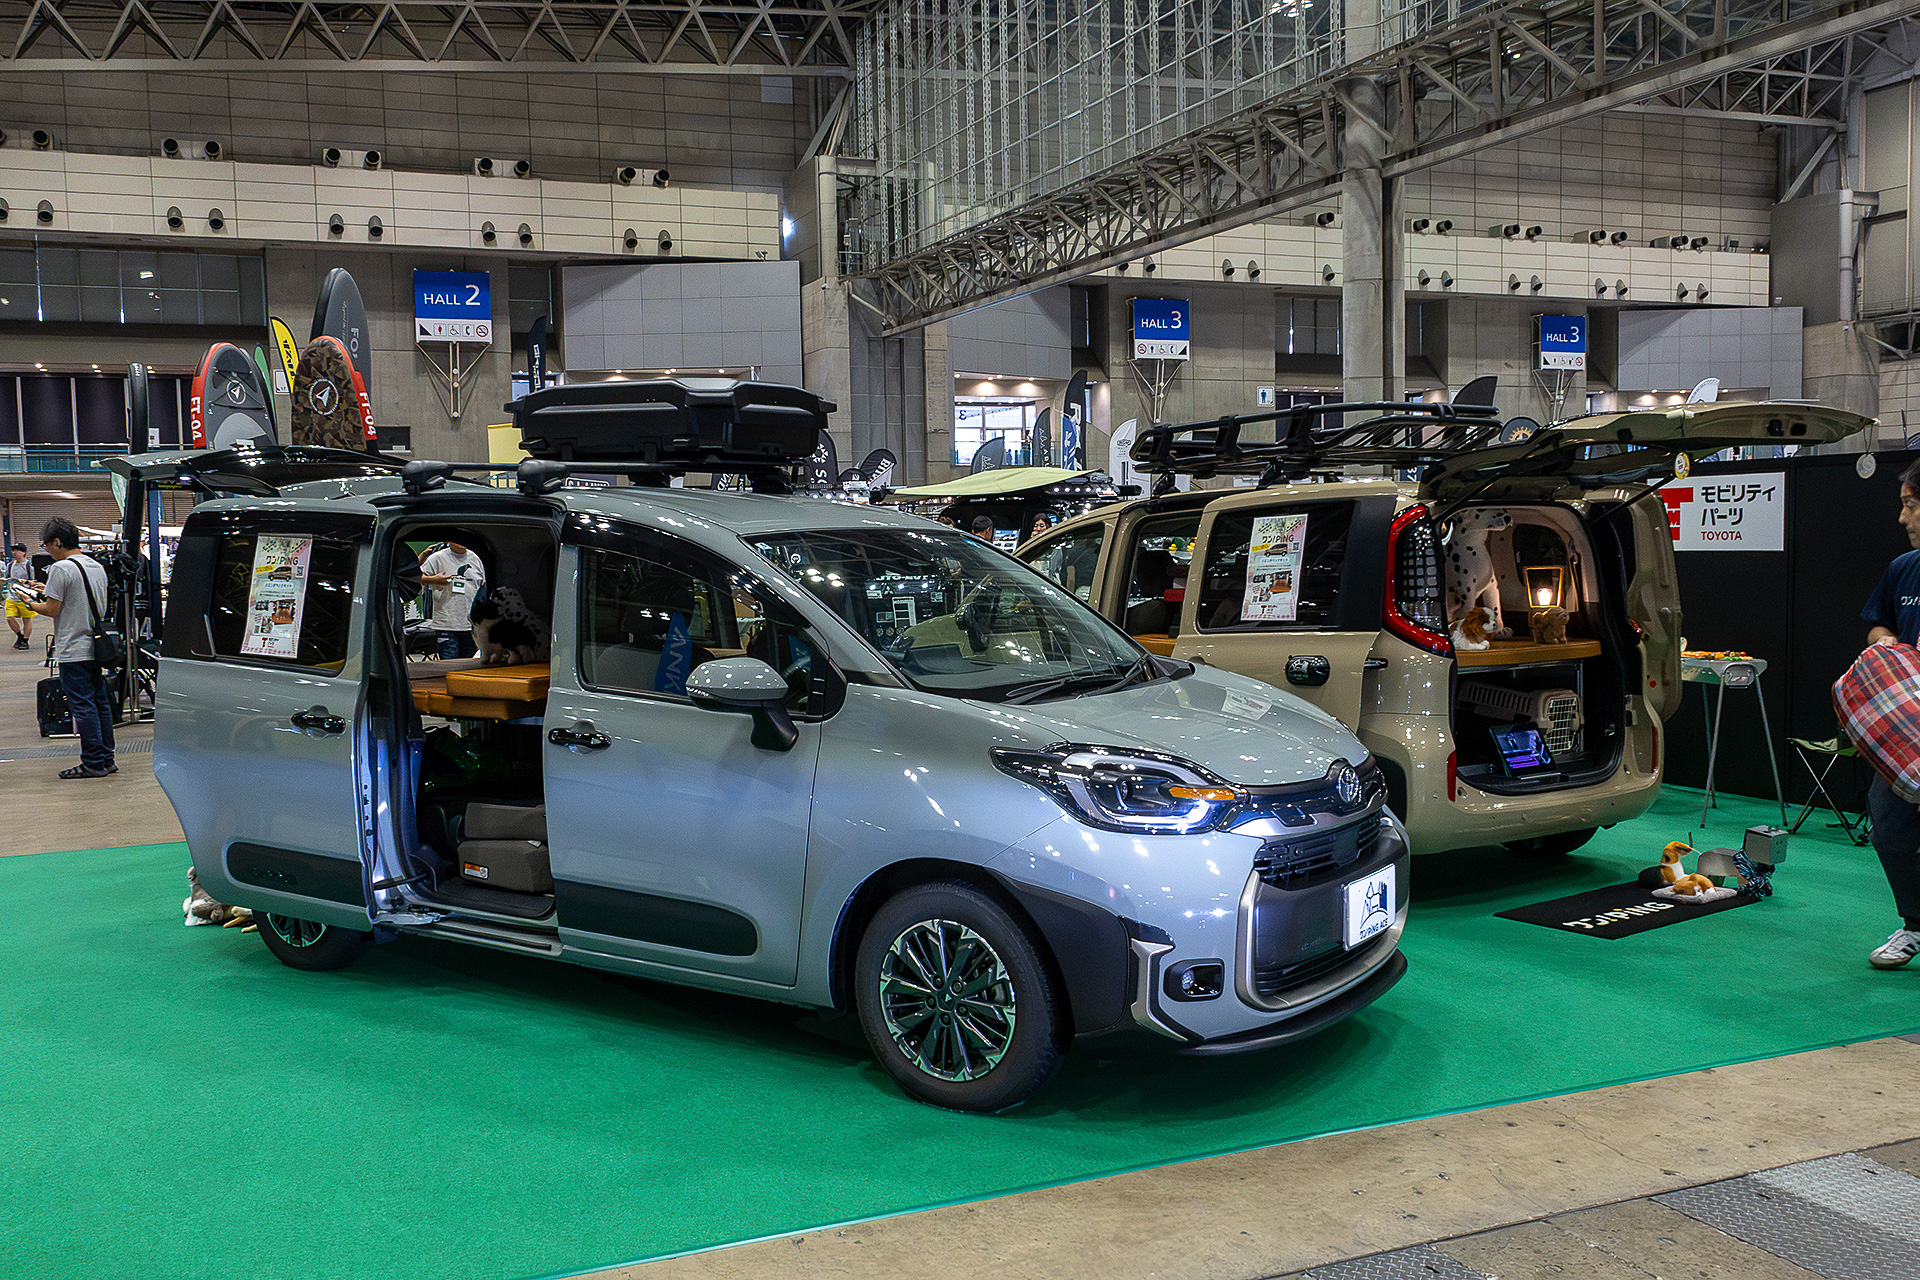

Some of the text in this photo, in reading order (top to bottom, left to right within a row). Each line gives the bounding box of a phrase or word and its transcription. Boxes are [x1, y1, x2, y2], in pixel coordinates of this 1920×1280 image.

[423, 284, 481, 306] HALL 2
[1141, 310, 1182, 329] HALL 3
[1546, 326, 1580, 343] HALL 3
[359, 392, 377, 436] FT-04
[1701, 484, 1776, 503] モビリティ
[1701, 508, 1744, 526] パーツ
[1701, 530, 1743, 541] TOYOTA
